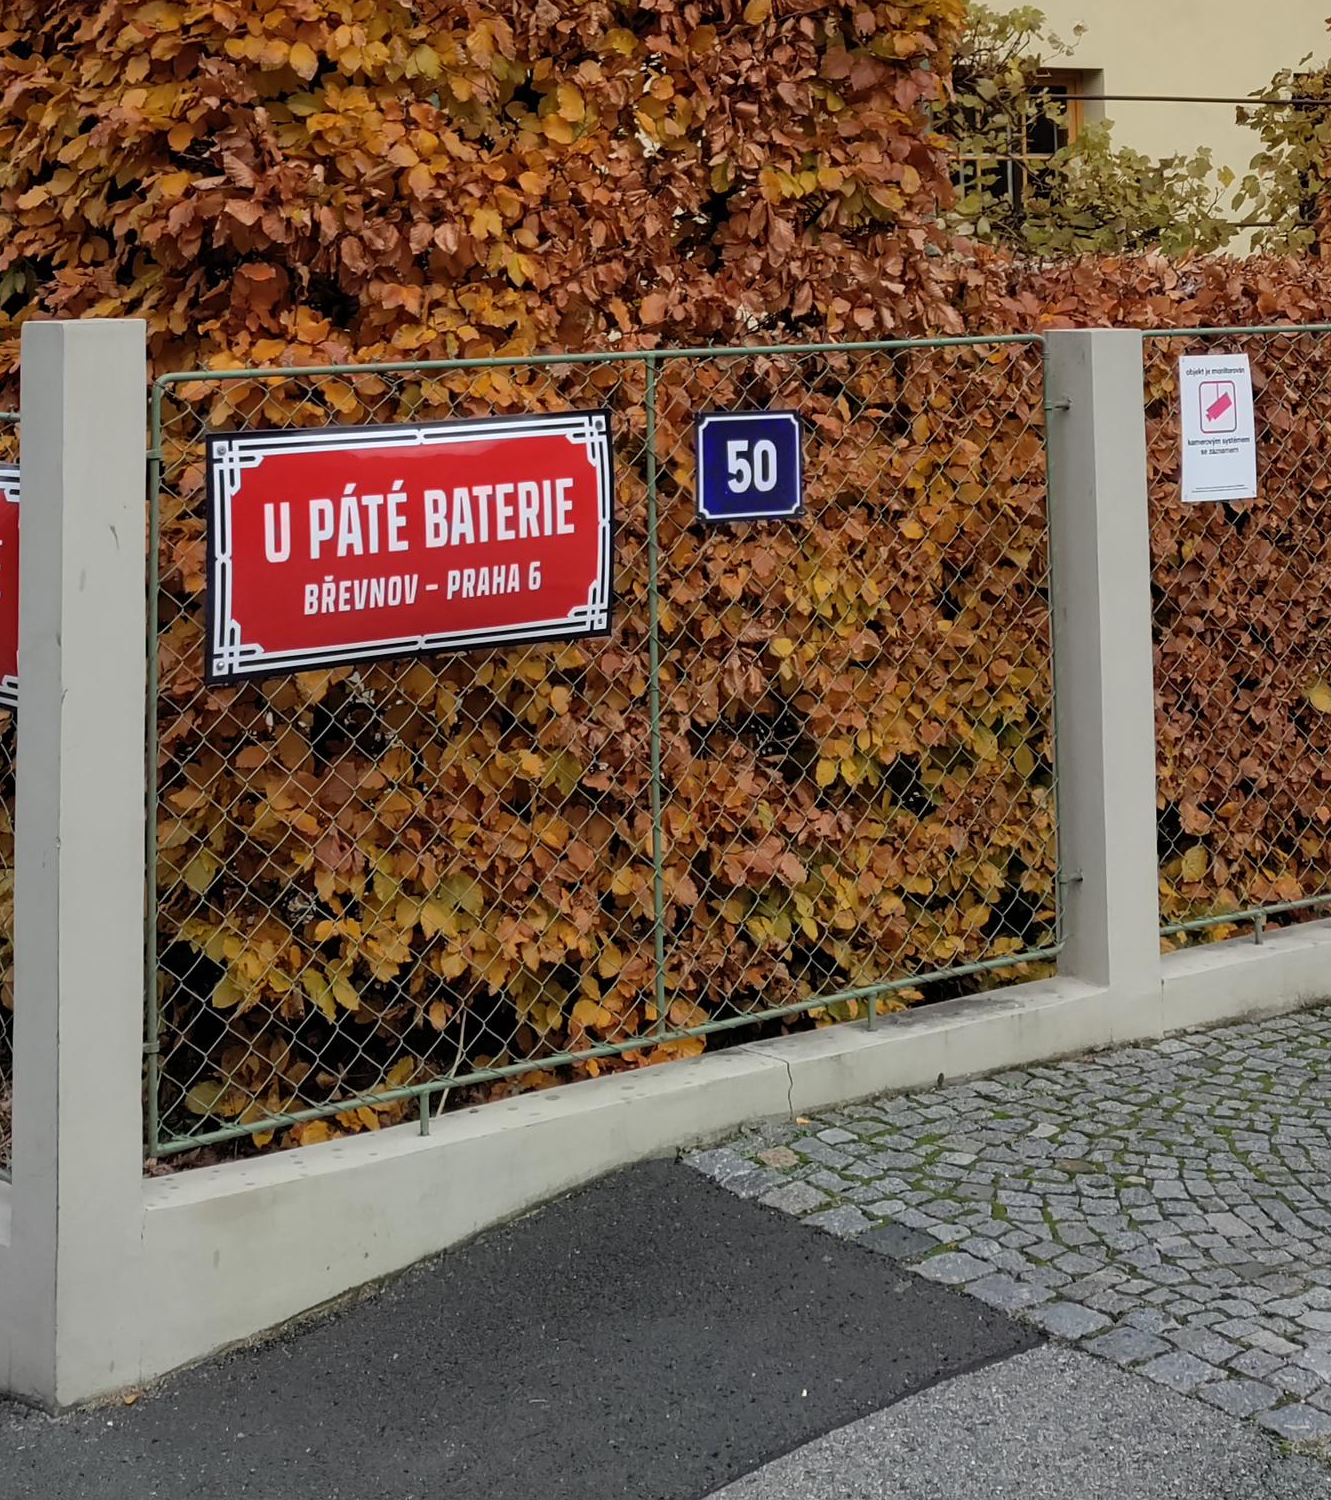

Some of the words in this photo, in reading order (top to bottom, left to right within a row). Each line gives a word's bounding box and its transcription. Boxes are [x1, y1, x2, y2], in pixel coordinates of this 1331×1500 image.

[1186, 368, 1204, 377] objekt
[1211, 367, 1245, 375] monitorován
[727, 439, 778, 493] 50
[1188, 437, 1221, 446] kamerovým
[1222, 436, 1250, 445] systémem
[264, 502, 291, 563] U
[309, 479, 409, 560] PÁTÉ
[424, 477, 575, 548] BATERIE
[304, 574, 418, 615] BŘEVNOV
[447, 563, 520, 600] PRAHA
[528, 561, 541, 590] 6
